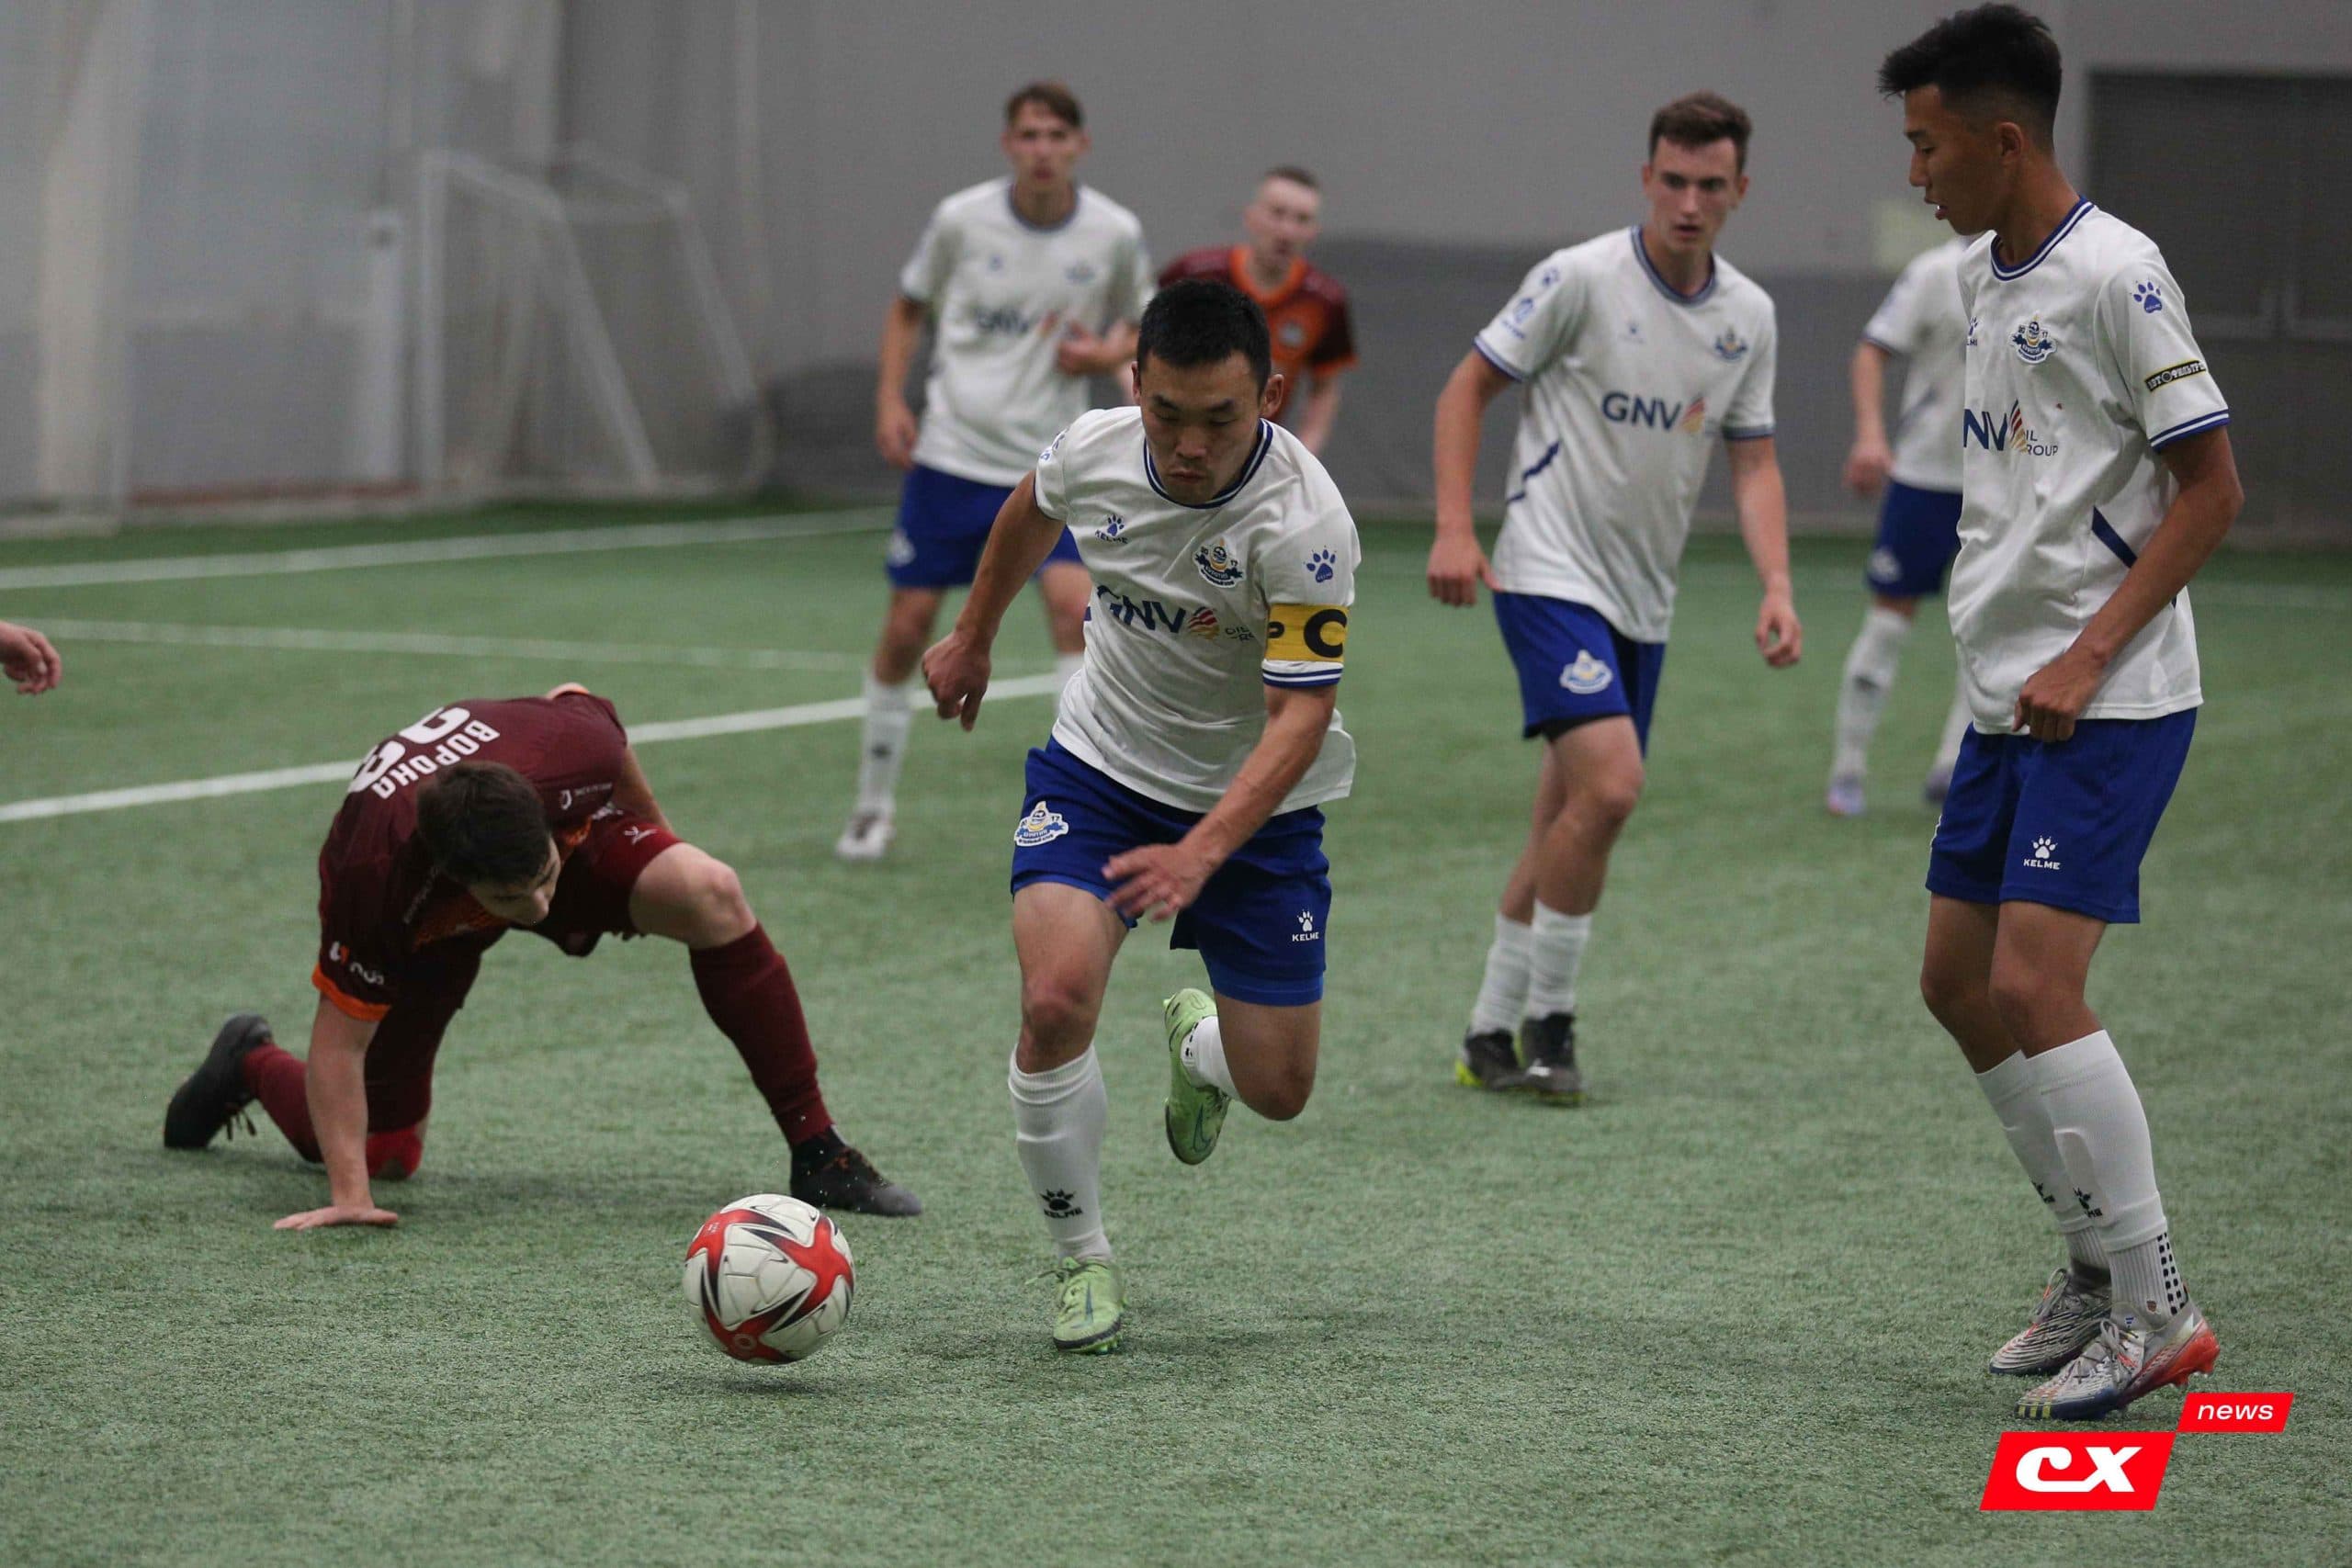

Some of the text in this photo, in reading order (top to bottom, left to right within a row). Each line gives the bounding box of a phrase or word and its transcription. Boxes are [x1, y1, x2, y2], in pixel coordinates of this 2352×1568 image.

[1601, 391, 1682, 431] GNV
[1962, 409, 2038, 452] NV IL
[2026, 445, 2059, 457] ROUP
[371, 719, 501, 799] ВОРОНА
[2023, 858, 2061, 870] KELME
[1292, 931, 1319, 942] KELME
[1043, 1206, 1082, 1219] KELME
